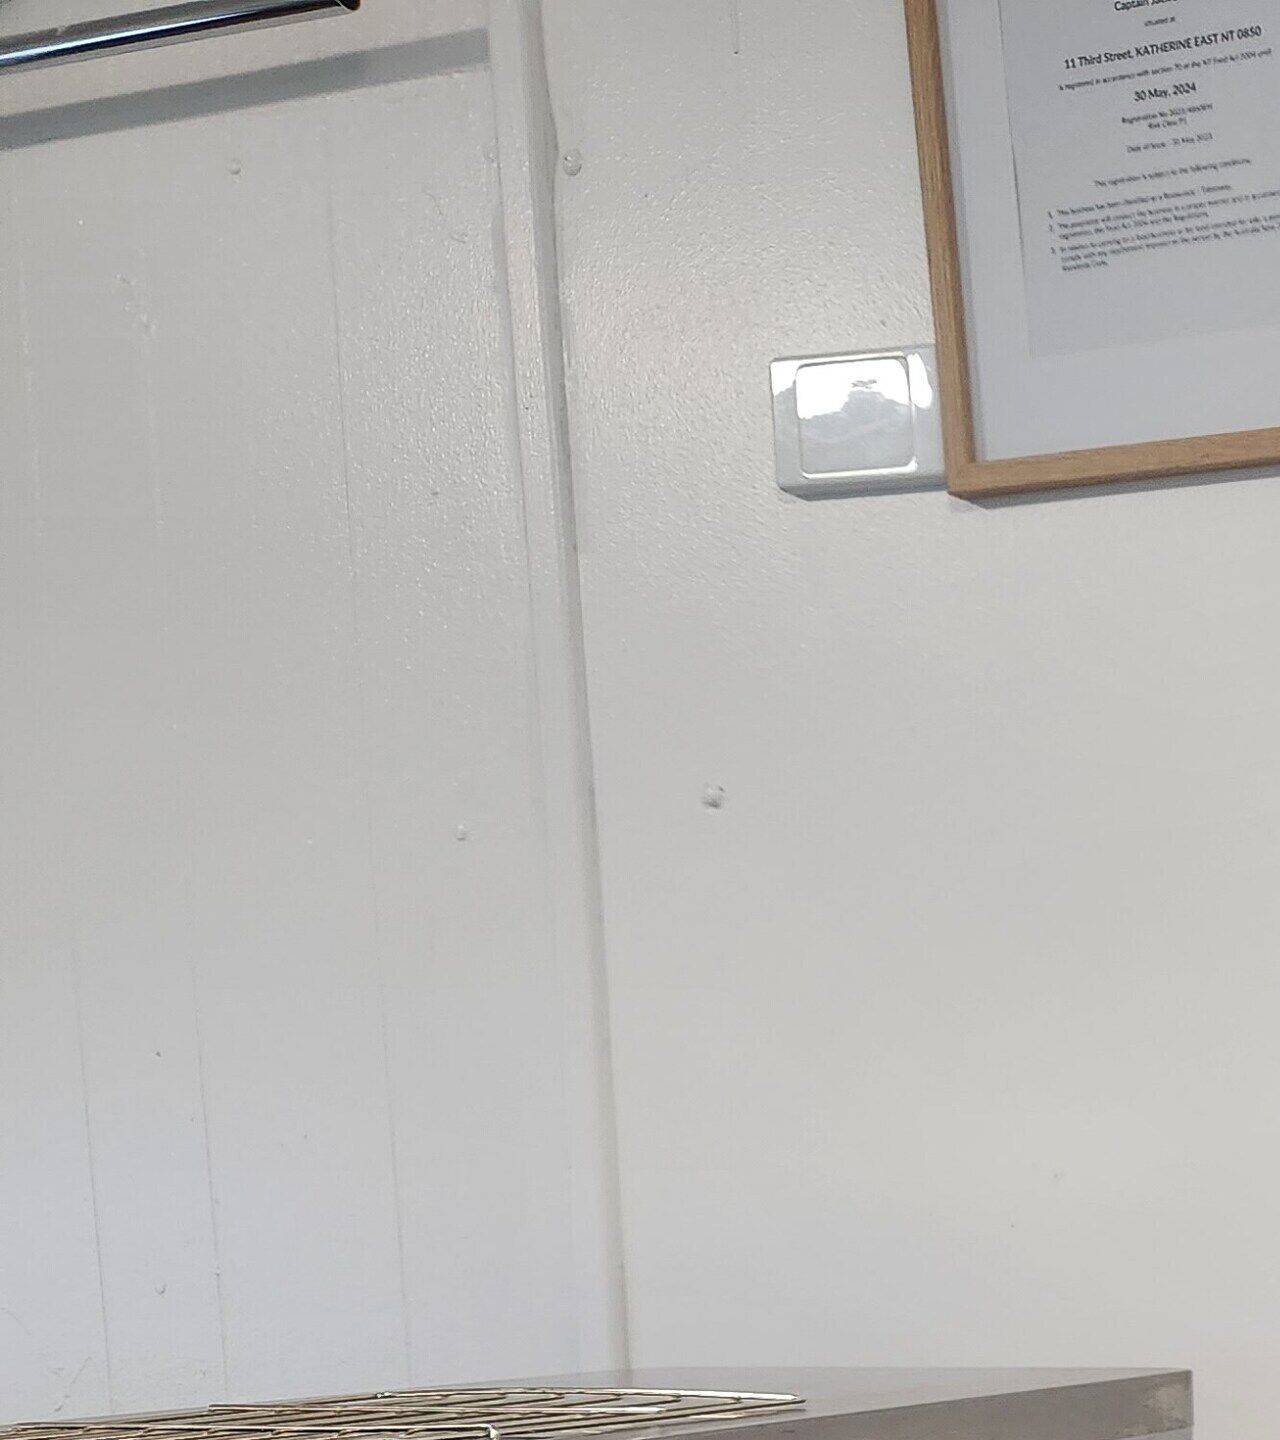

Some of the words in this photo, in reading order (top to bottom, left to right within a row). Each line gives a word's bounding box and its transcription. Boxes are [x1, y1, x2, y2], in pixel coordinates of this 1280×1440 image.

[1115, 0, 1149, 11] Captain
[1064, 59, 1077, 69] 11
[1078, 55, 1102, 67] Third
[1104, 52, 1133, 62] Street,
[1135, 38, 1192, 57] KATHERINE
[1195, 34, 1218, 47] EAST
[1221, 30, 1235, 43] NT
[1237, 26, 1261, 39] 0850
[1135, 91, 1146, 102] 30
[1173, 82, 1196, 96] 2024
